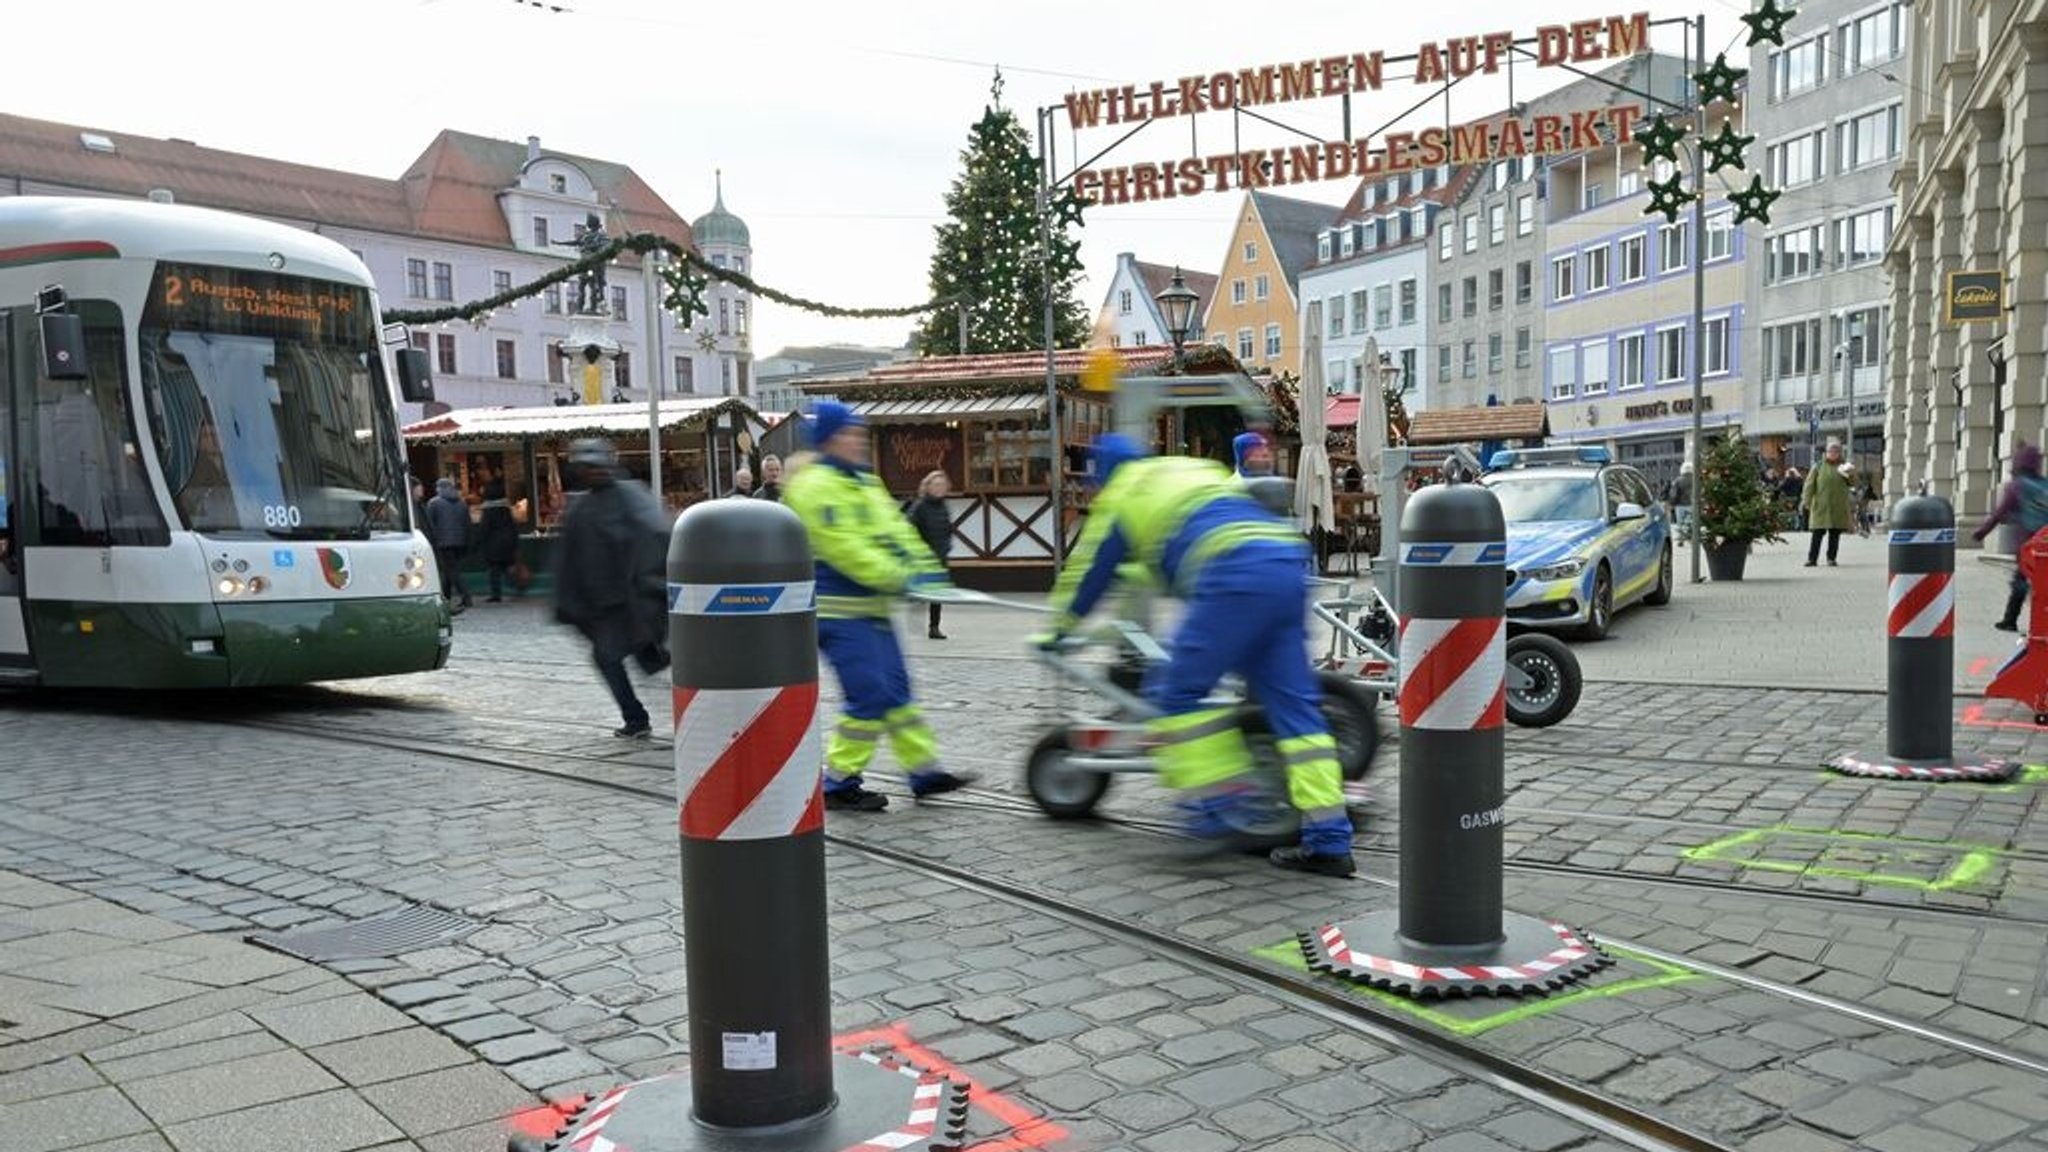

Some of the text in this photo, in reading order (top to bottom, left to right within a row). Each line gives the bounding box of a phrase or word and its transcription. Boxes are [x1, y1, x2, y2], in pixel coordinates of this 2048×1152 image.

[1064, 11, 1650, 130] WILLKOMMEN AUF DEM
[1073, 103, 1642, 208] CHRISTKINDLESMARKT
[164, 275, 184, 305] 2
[263, 505, 301, 528] 880
